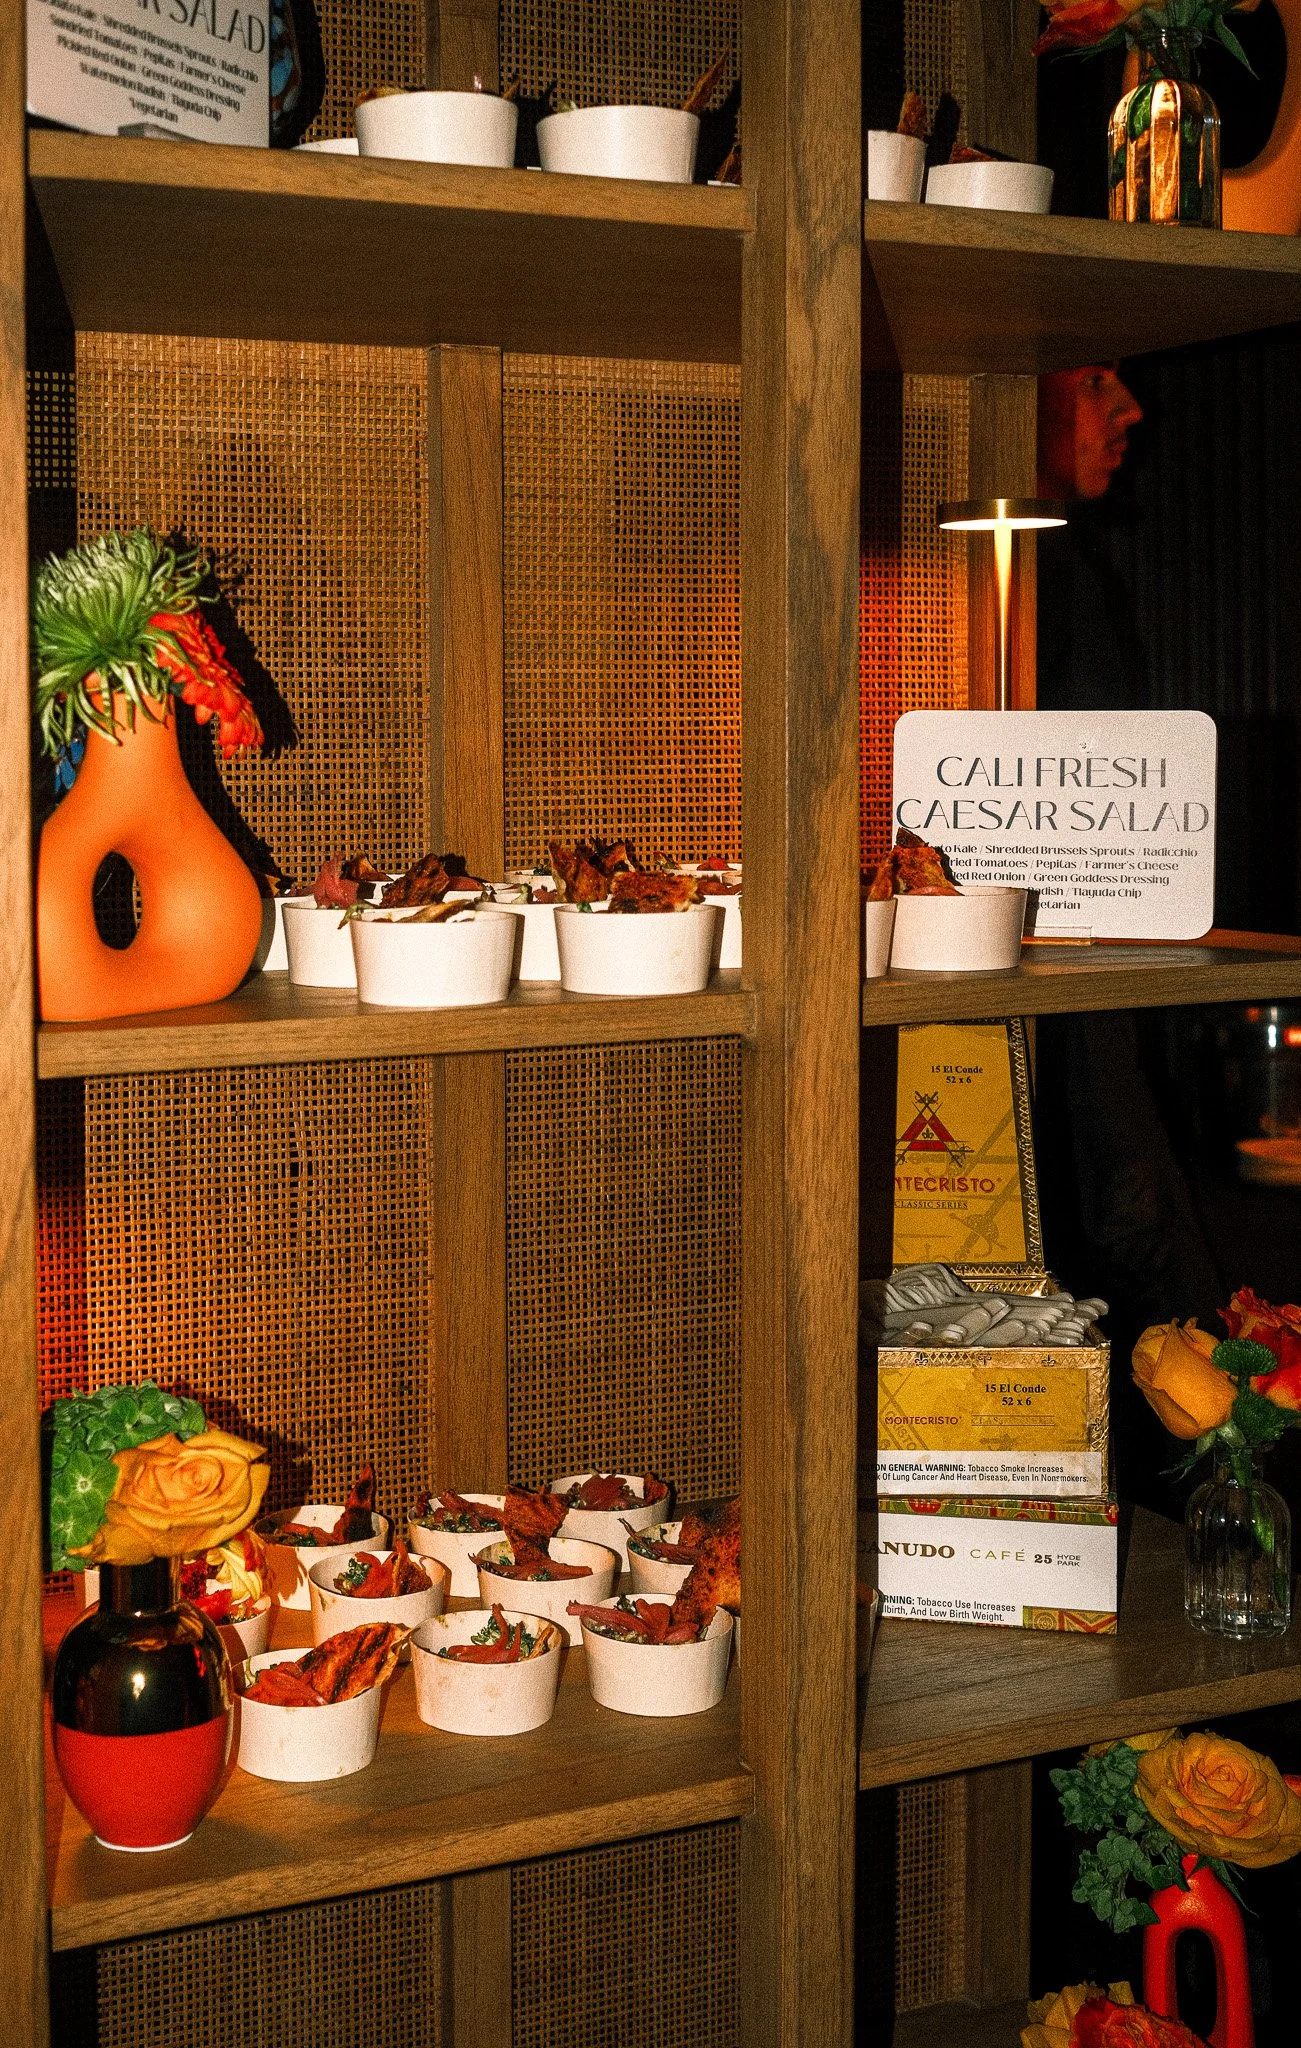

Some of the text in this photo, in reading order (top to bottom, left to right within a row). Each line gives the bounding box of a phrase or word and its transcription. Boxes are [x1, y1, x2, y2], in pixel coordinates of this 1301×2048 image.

[169, 0, 265, 54] SALAD
[184, 45, 217, 67] Sprouts
[221, 59, 259, 83] Radicchio
[143, 47, 175, 69] Pepitas
[217, 75, 246, 96] Cheese
[141, 65, 169, 84] Green
[205, 88, 240, 113] Dressing
[936, 756, 1167, 788] CALI FRESH
[895, 798, 1210, 833] CAESAR SALAD
[953, 844, 978, 854] Kale
[985, 844, 1039, 855] Shredded
[1040, 845, 1088, 856] Brussels
[1090, 846, 1135, 857] Sprouts
[1143, 847, 1198, 857] Radicchio
[973, 858, 1028, 868] Tomatoes
[1036, 859, 1077, 870] Pepitas
[1085, 860, 1135, 870] Farmer's
[1137, 861, 1179, 871] Cheese
[971, 871, 992, 881] Red
[994, 871, 1026, 881] Onion
[1033, 872, 1068, 882] Green
[1070, 873, 1119, 883] Goddess
[1120, 874, 1170, 886] Dressing
[1072, 887, 1116, 898] Tlayuda
[1118, 888, 1142, 899] Chip
[931, 1065, 984, 1074] 15 El Conde
[946, 1076, 957, 1084] 52
[966, 1076, 972, 1084] 6
[893, 1176, 996, 1193] NTECRISTO
[895, 1200, 968, 1209] CLASSIC SERIES
[985, 1384, 1047, 1393] 15 El Conde
[1002, 1397, 1014, 1406] 52
[1025, 1397, 1032, 1406] 6
[884, 1416, 959, 1425] MONTECRISTO
[888, 1464, 923, 1472] GENERAL
[925, 1464, 966, 1472] WARNING:
[968, 1464, 999, 1472] Tobacco
[1000, 1464, 1025, 1473] Smoke
[1027, 1465, 1064, 1473] Increases
[882, 1473, 892, 1481] Of
[892, 1473, 910, 1482] Lung
[912, 1473, 938, 1481] Cancer
[940, 1473, 955, 1481] And
[957, 1473, 977, 1481] Heart
[978, 1473, 1010, 1482] Disease,
[1012, 1473, 1030, 1482] Even
[1031, 1474, 1039, 1482] In
[1041, 1474, 1089, 1483] Nonsmokers.
[866, 1541, 1053, 1564] ANUDO CAFÉ 25
[916, 1597, 953, 1608] Tobacco
[955, 1599, 971, 1609] Use
[973, 1600, 1016, 1612] Increases
[910, 1606, 927, 1616] And
[929, 1607, 947, 1617] Low
[950, 1609, 970, 1619] Birth
[972, 1610, 1005, 1623] Weight.
